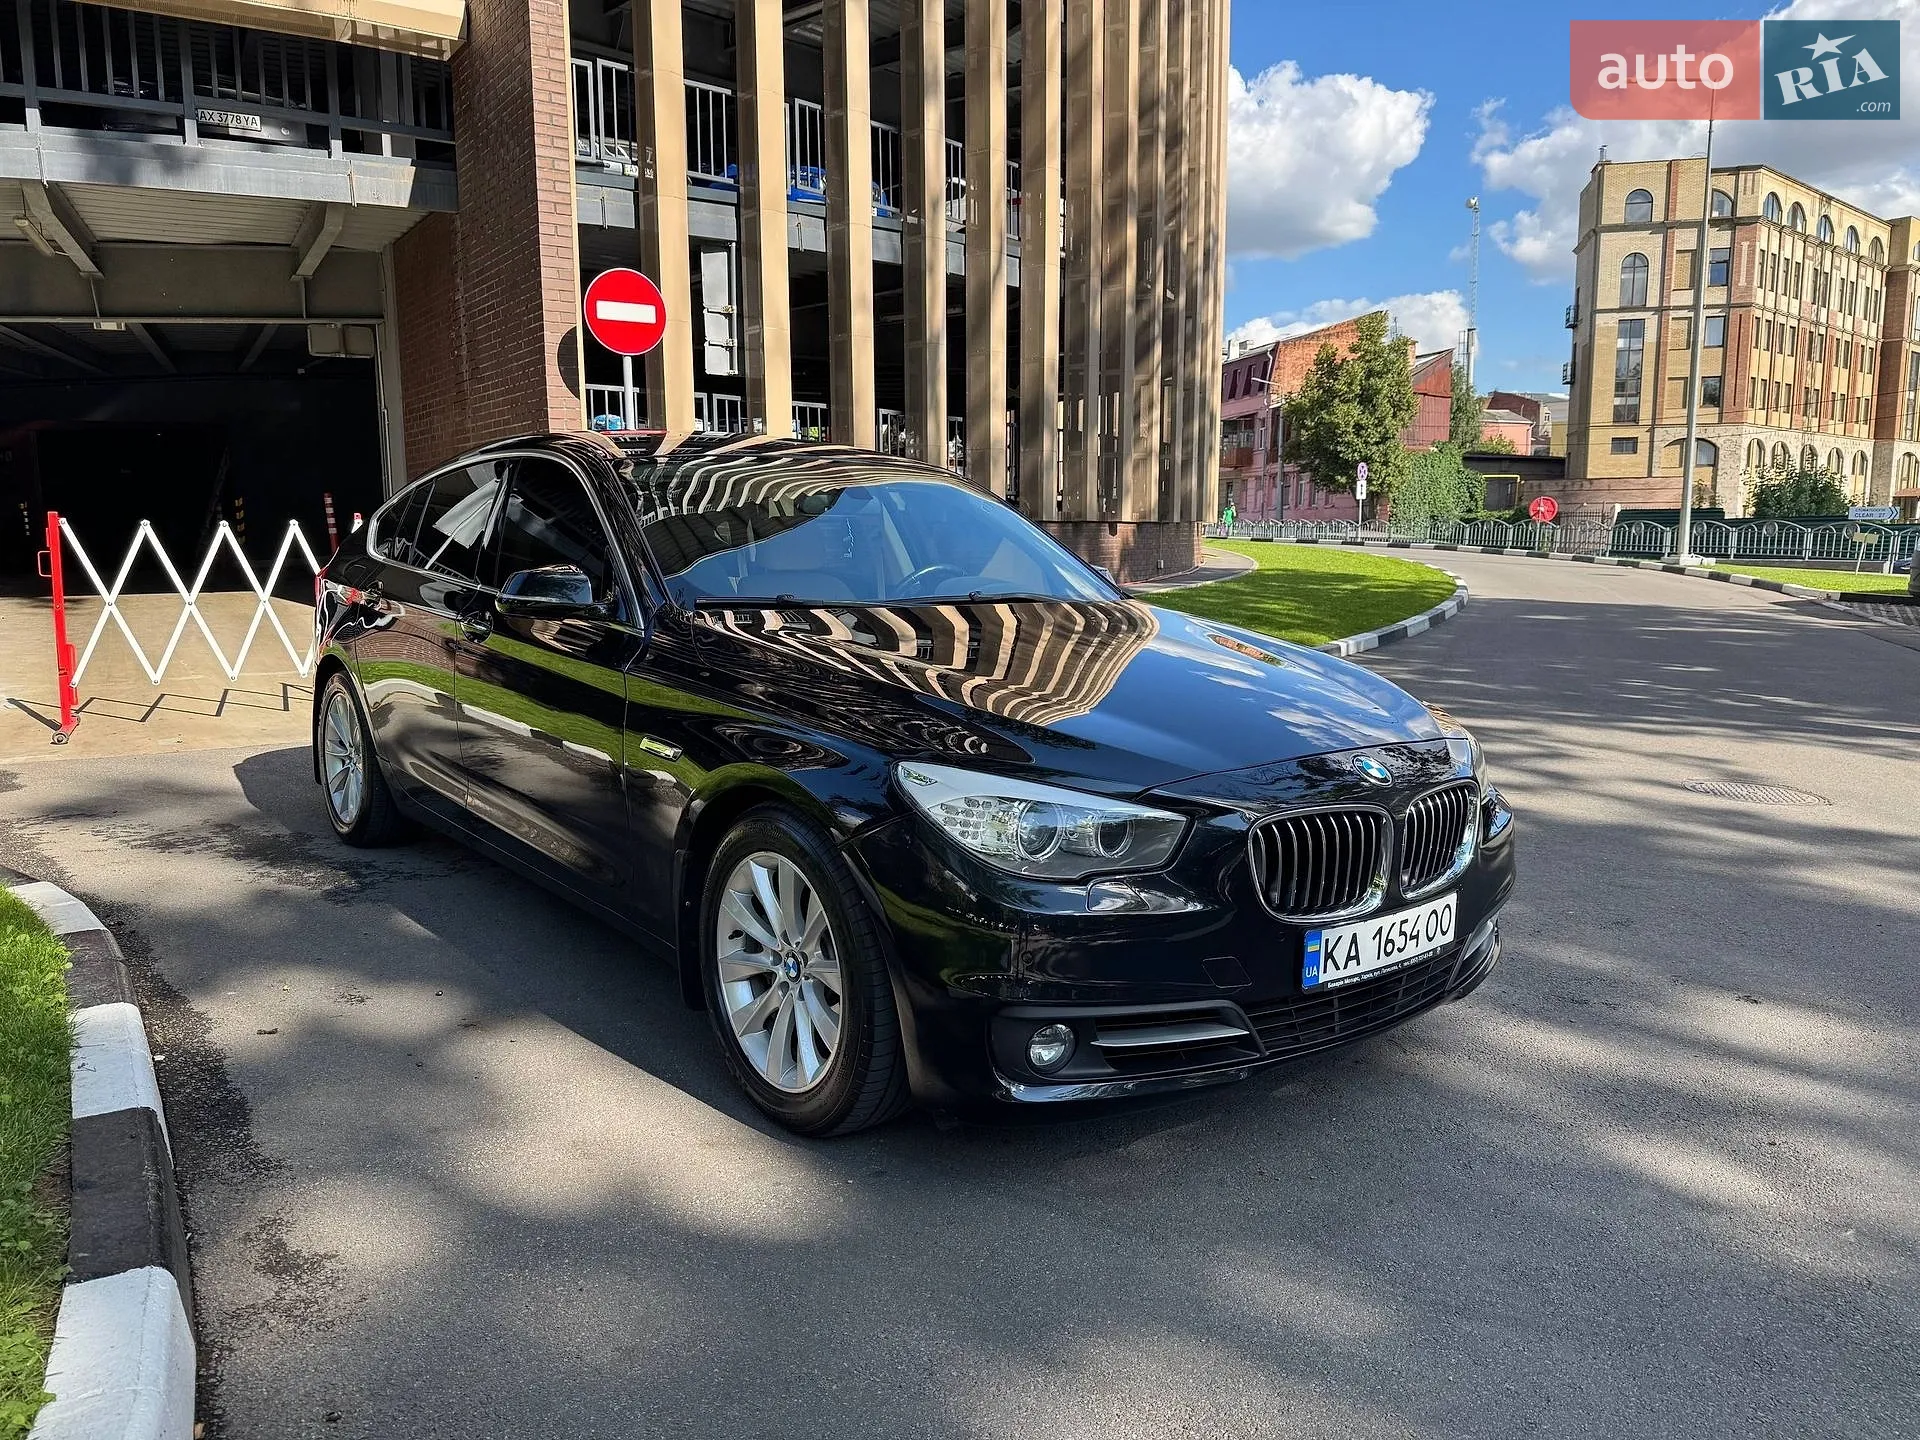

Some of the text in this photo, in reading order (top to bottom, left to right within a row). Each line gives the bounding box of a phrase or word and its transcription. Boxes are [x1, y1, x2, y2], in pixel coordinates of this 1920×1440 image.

[200, 110, 214, 121] AX
[216, 112, 242, 124] 3778
[1323, 932, 1361, 974] KA
[1372, 914, 1421, 960] 1654
[1306, 965, 1318, 978] UA
